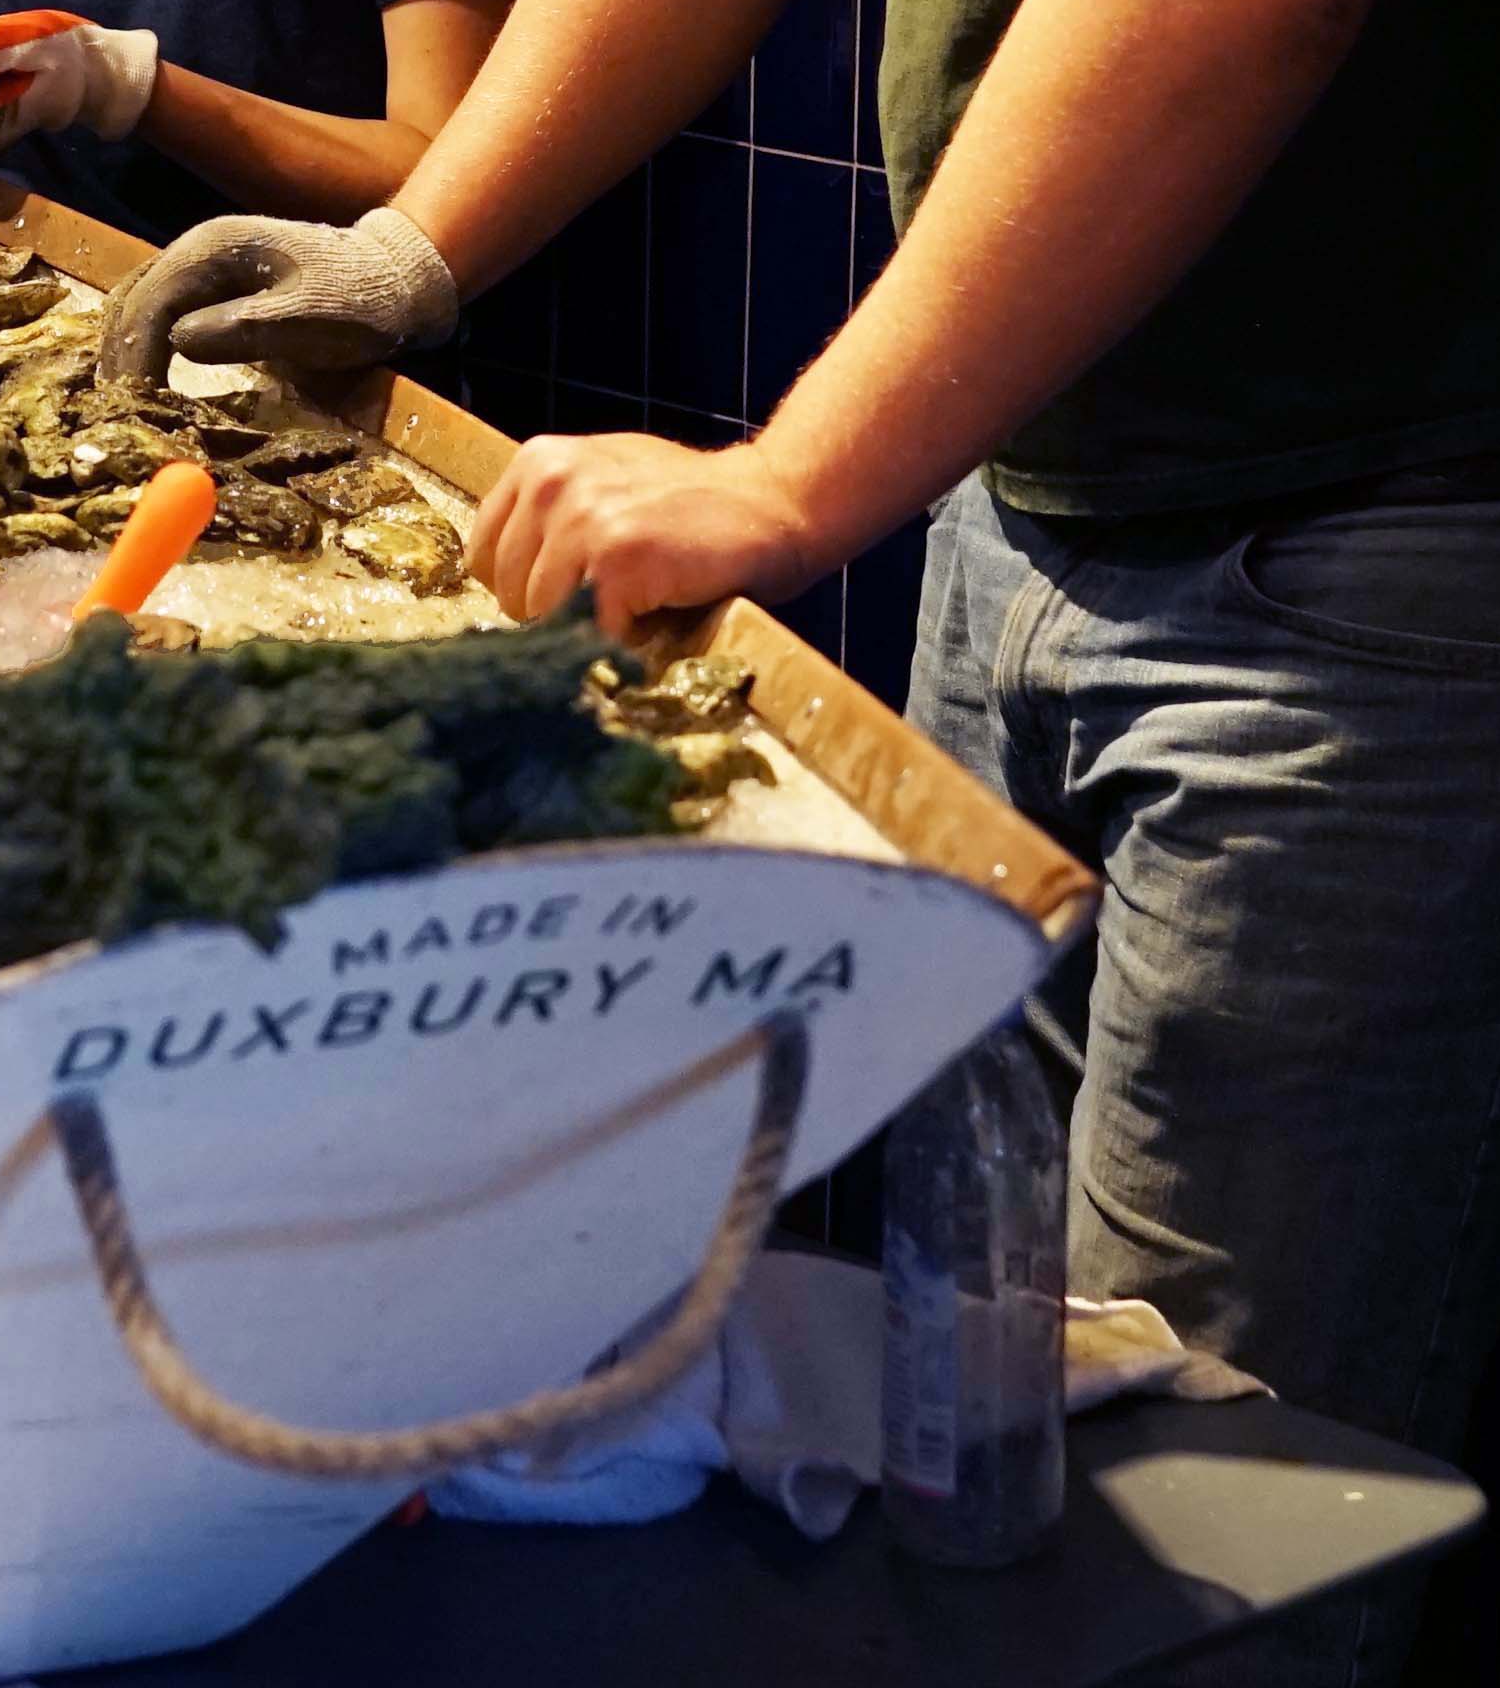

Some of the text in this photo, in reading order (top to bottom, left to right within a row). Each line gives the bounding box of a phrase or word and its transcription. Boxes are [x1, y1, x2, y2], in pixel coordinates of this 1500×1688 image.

[331, 893, 699, 975] MADE IN
[54, 938, 855, 1081] DUXBURY MA
